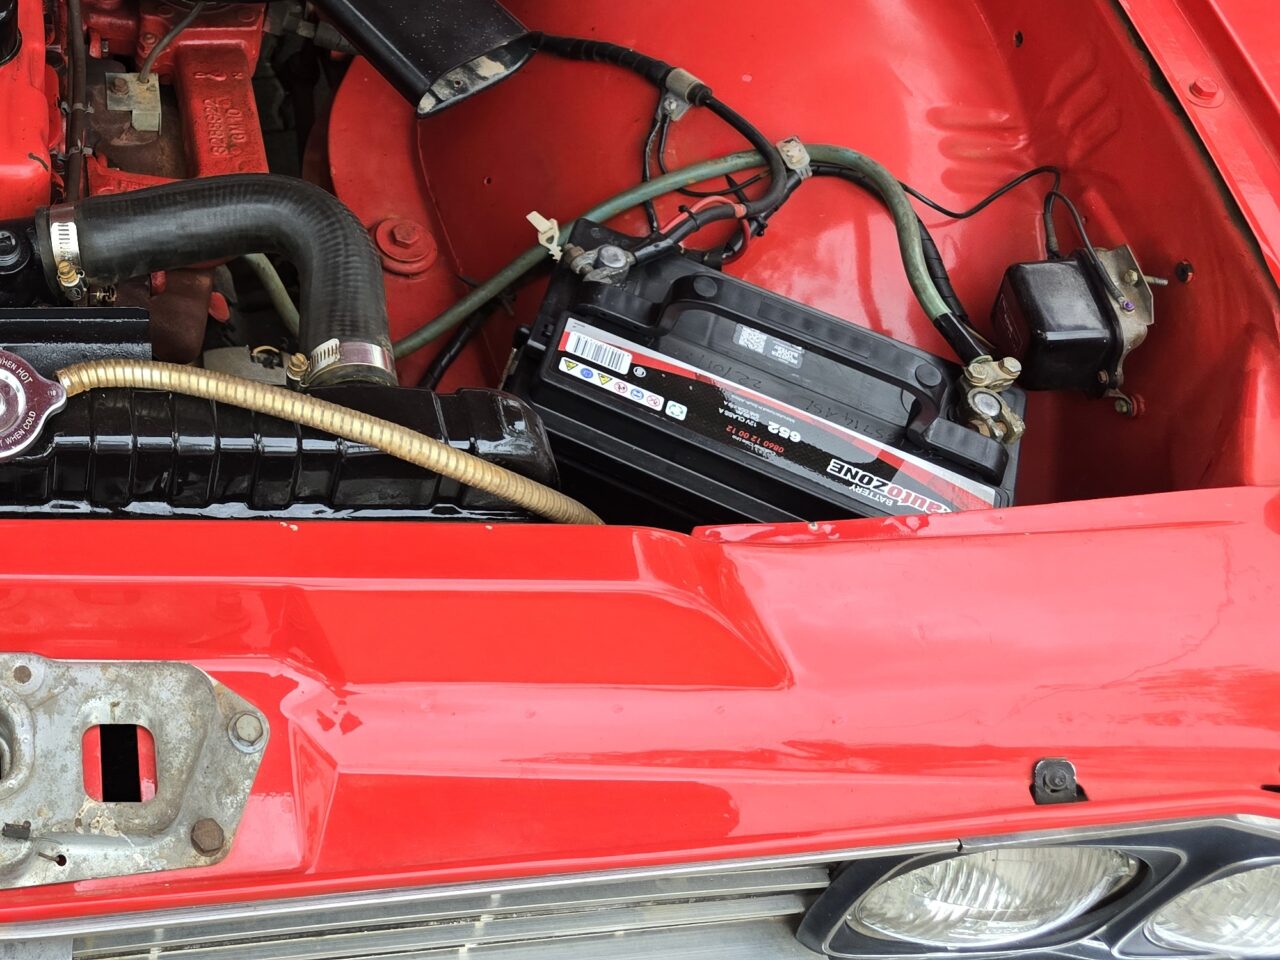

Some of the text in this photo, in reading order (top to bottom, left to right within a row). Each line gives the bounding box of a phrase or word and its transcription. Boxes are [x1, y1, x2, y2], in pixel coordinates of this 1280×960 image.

[15, 367, 34, 385] HOT
[722, 409, 746, 423] CLASS
[744, 418, 757, 427] 12V
[4, 429, 26, 446] WHEN
[24, 410, 37, 431] COLD
[767, 421, 801, 443] 652
[725, 425, 785, 454] 0860 12 00 12
[849, 483, 894, 507] BATTERY
